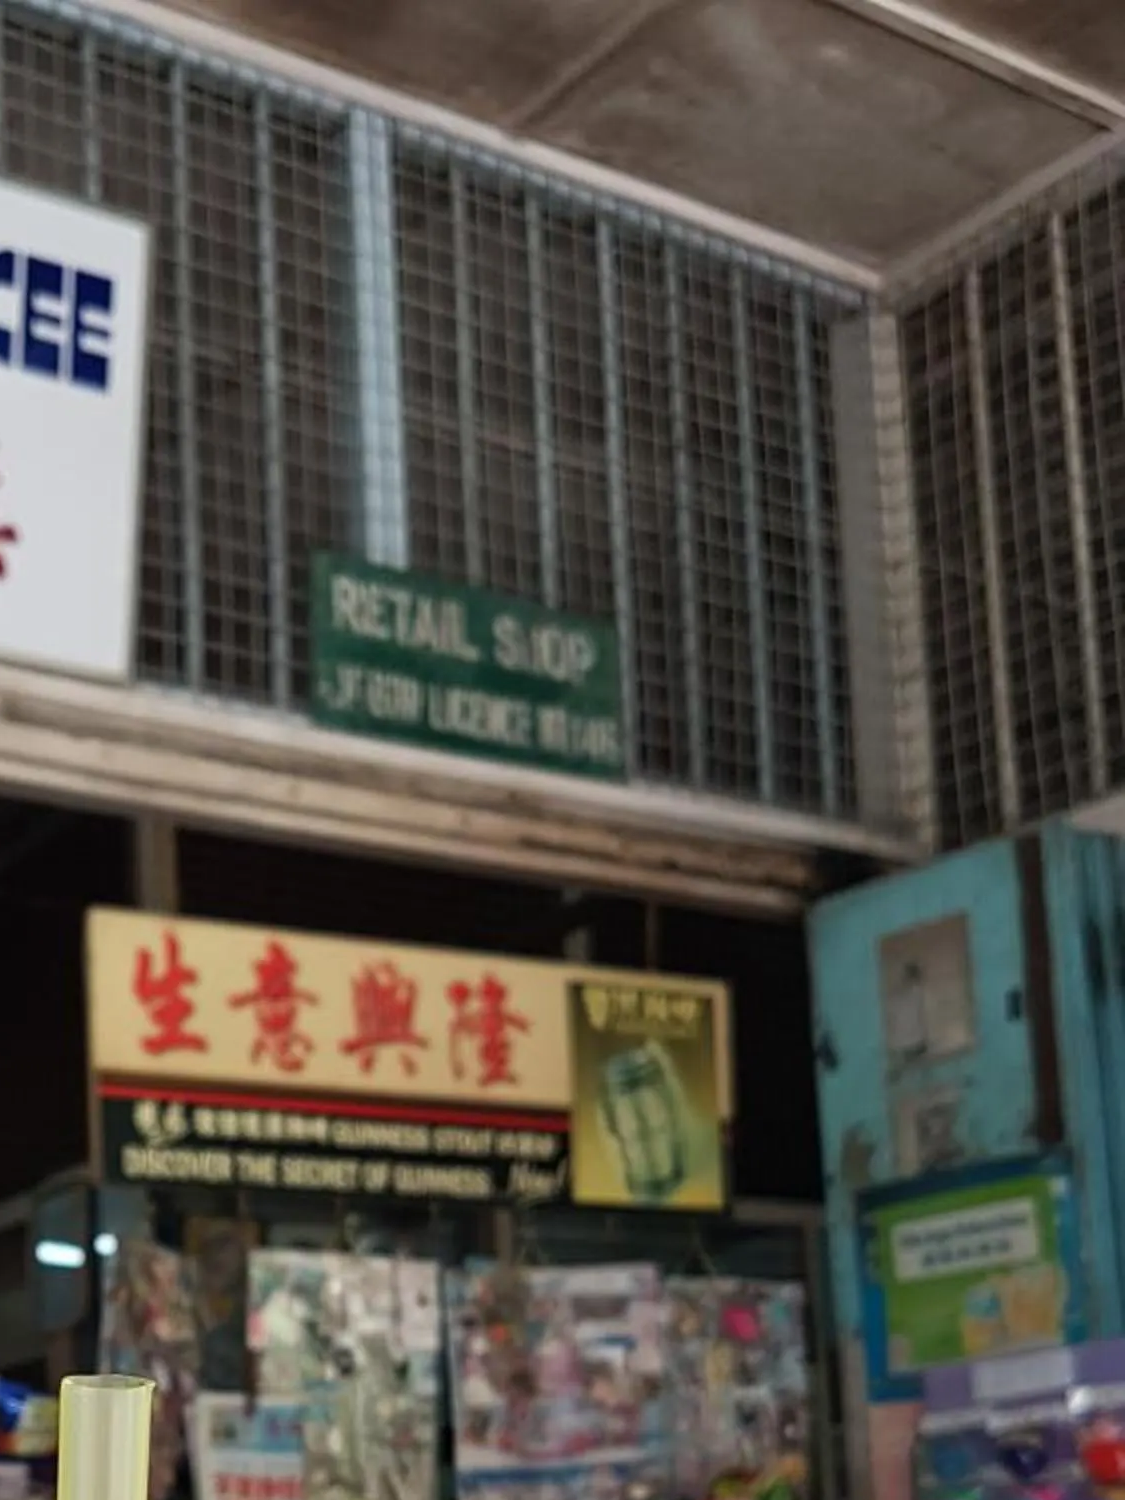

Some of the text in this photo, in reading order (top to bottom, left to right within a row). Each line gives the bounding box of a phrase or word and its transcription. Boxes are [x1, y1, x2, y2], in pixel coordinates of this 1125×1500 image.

[331, 573, 480, 662] RETAIL
[131, 929, 531, 1088] 生意興隆
[121, 1146, 232, 1182] DISCOVER
[236, 1153, 276, 1184] THE
[280, 1157, 359, 1191] SECRET
[362, 1161, 391, 1194] OF
